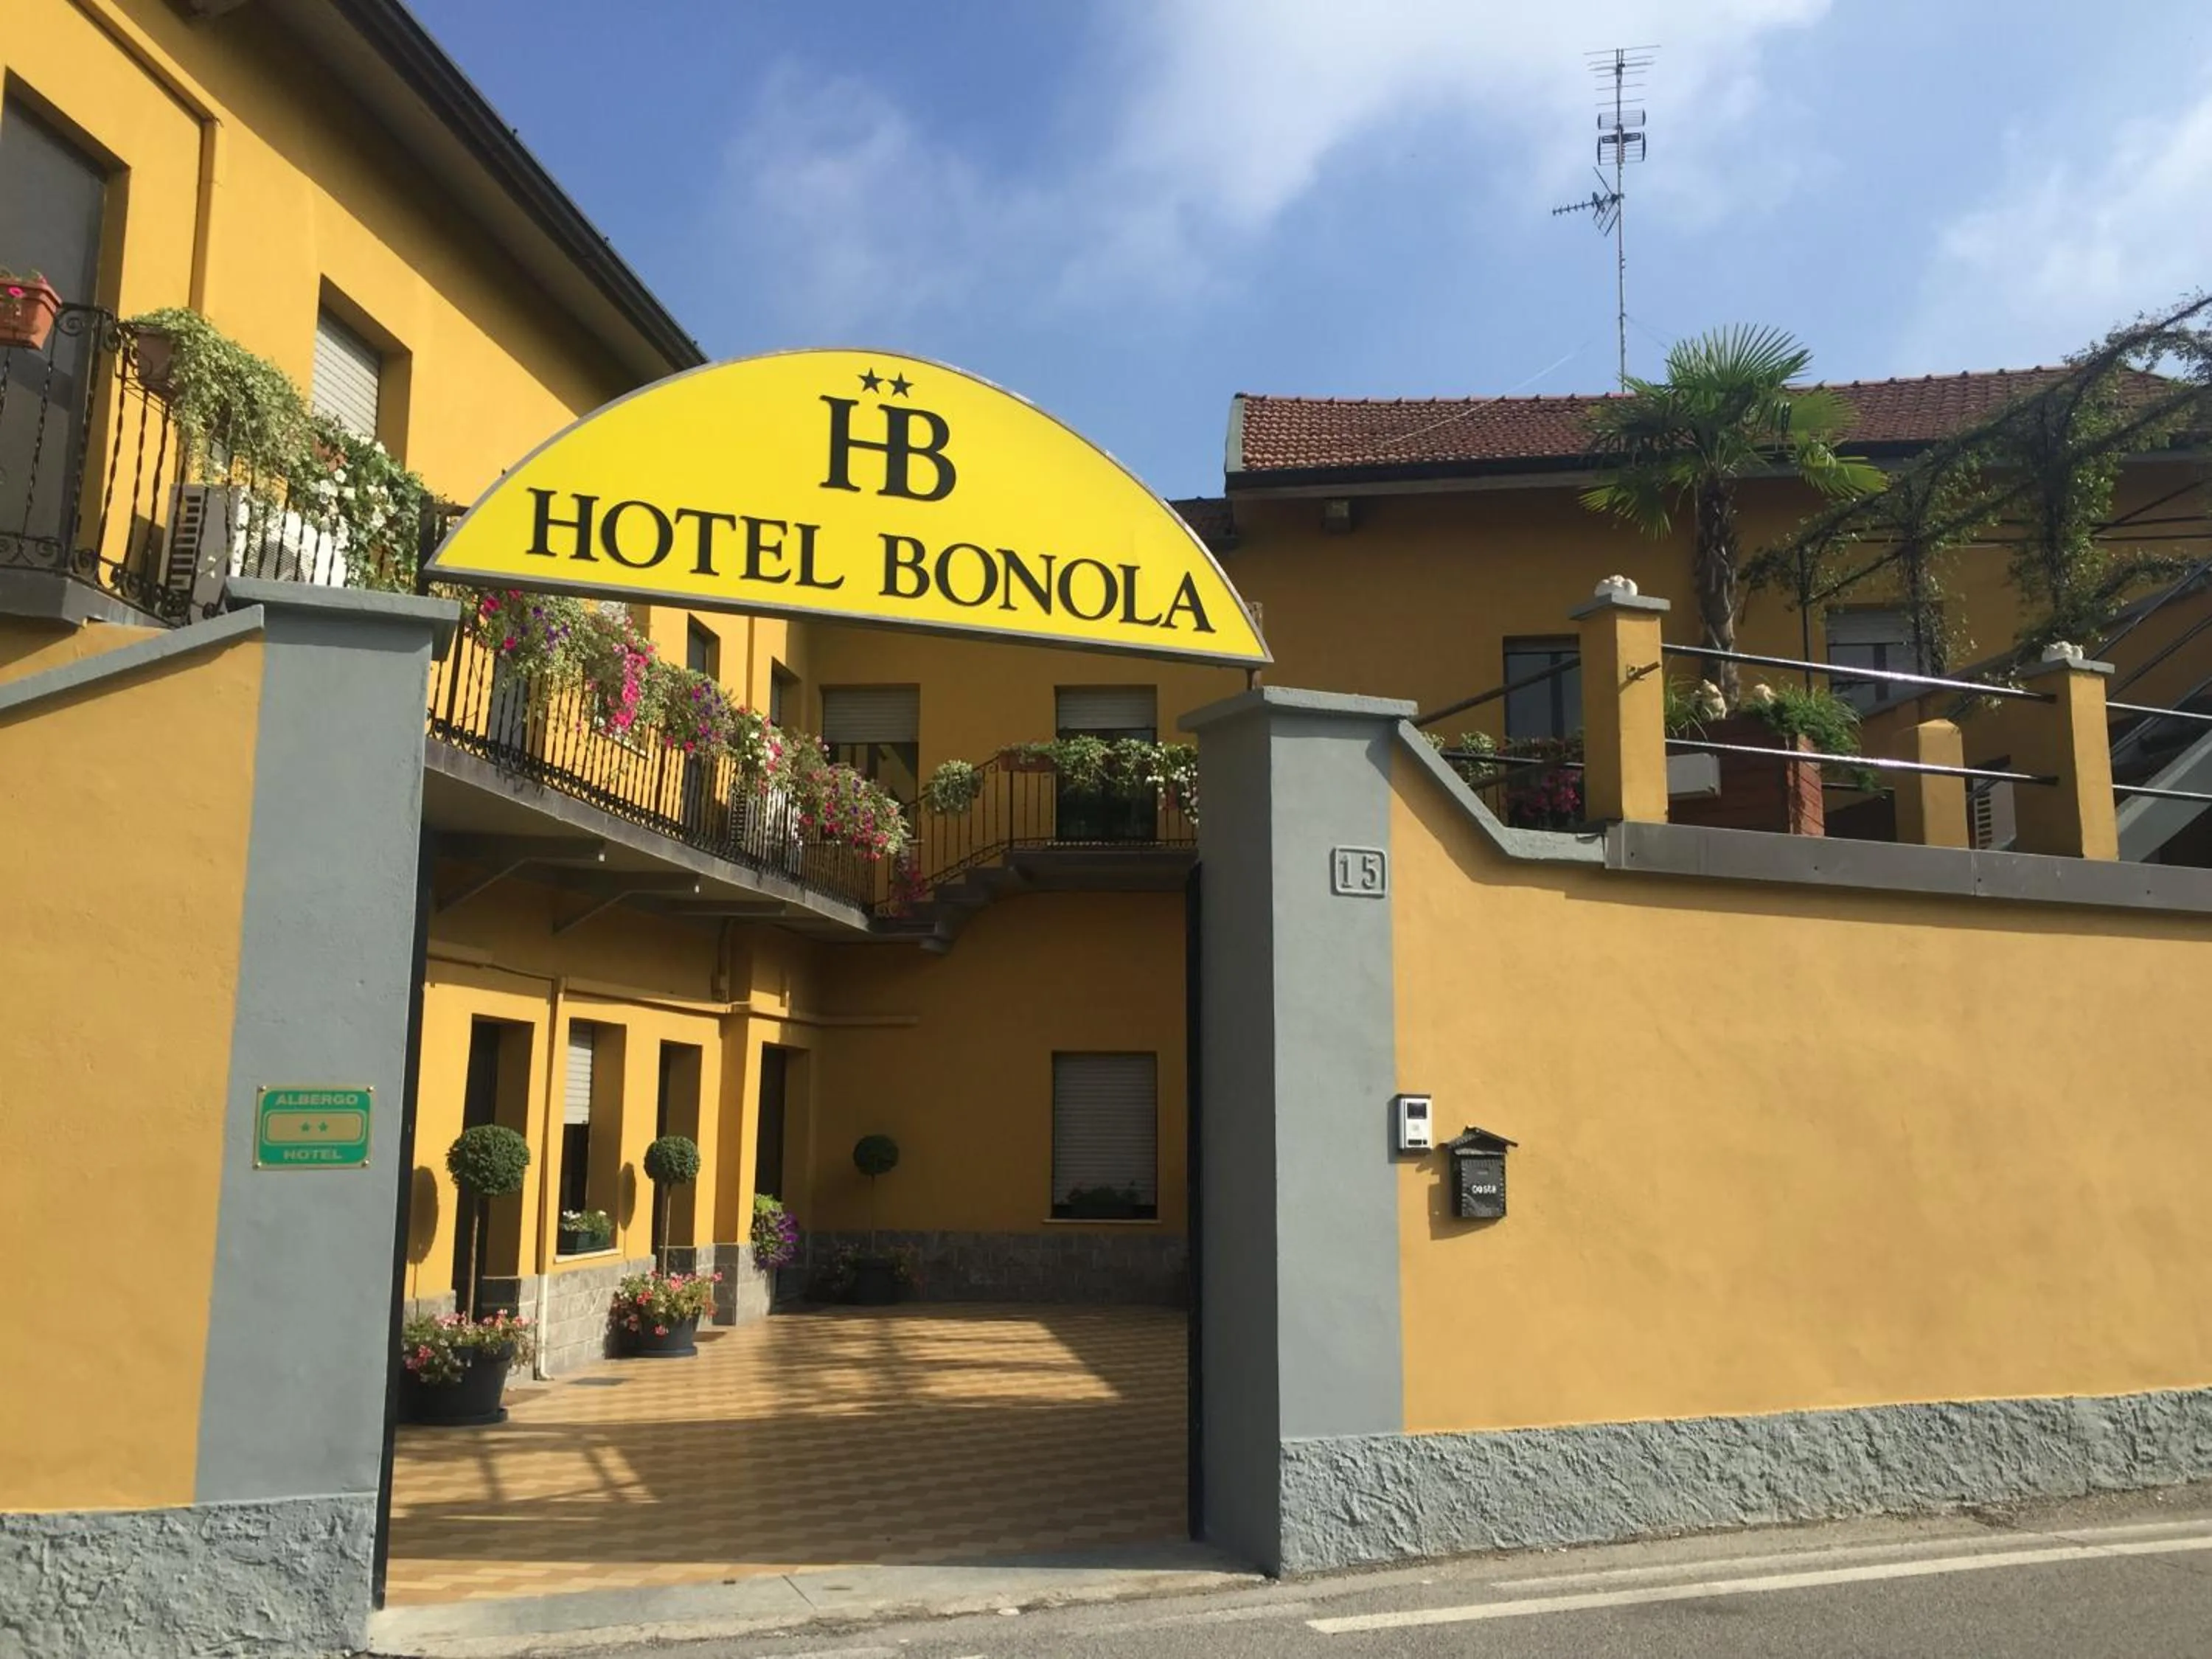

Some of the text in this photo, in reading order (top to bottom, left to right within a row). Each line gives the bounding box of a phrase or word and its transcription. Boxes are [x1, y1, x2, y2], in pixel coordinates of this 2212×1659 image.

[820, 394, 956, 501] HB
[526, 487, 1217, 633] HOTEL BONOLA
[1339, 854, 1378, 890] 15
[276, 1093, 359, 1105] ALBERGO
[283, 1150, 344, 1160] HOTEL
